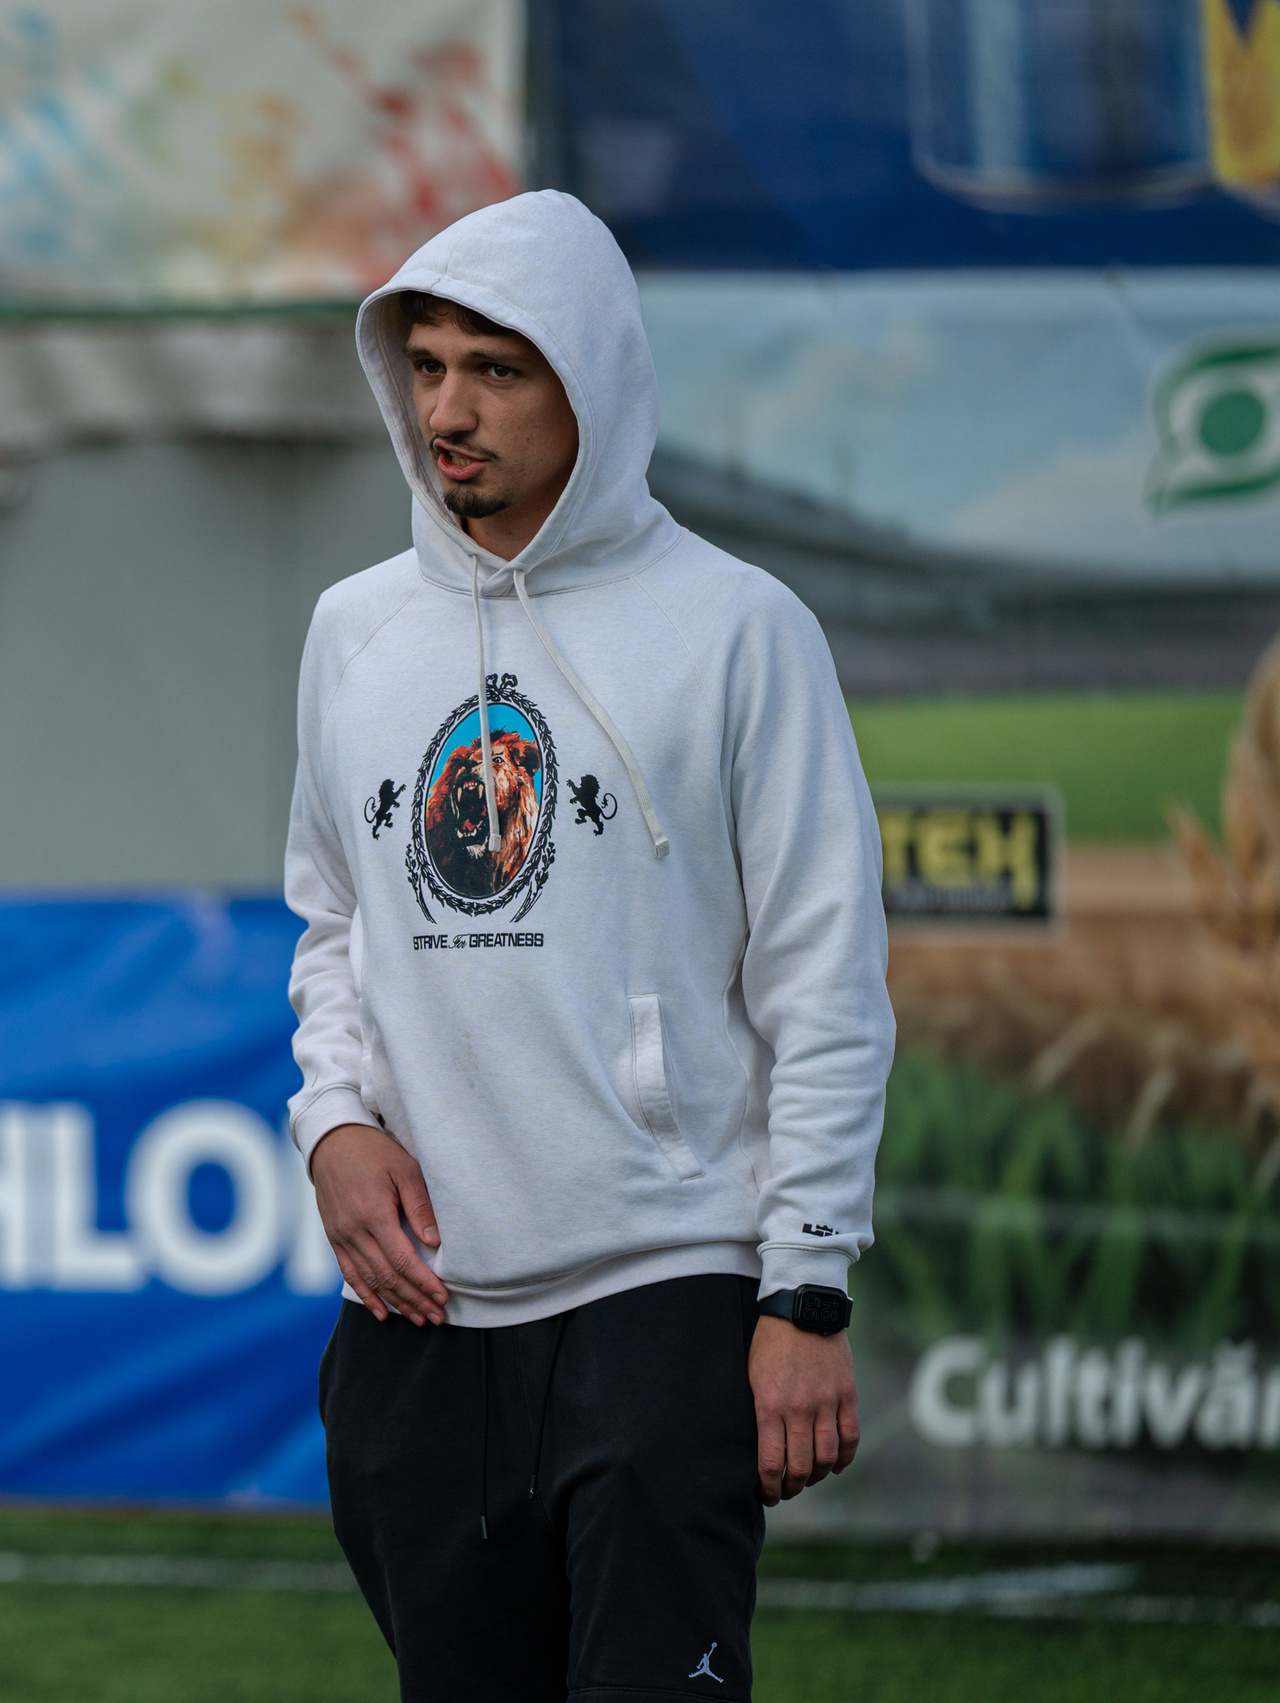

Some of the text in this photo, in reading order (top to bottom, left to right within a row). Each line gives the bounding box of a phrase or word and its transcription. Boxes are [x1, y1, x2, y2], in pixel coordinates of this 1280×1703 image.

[413, 932, 545, 950] STRIVE For GREATNESS
